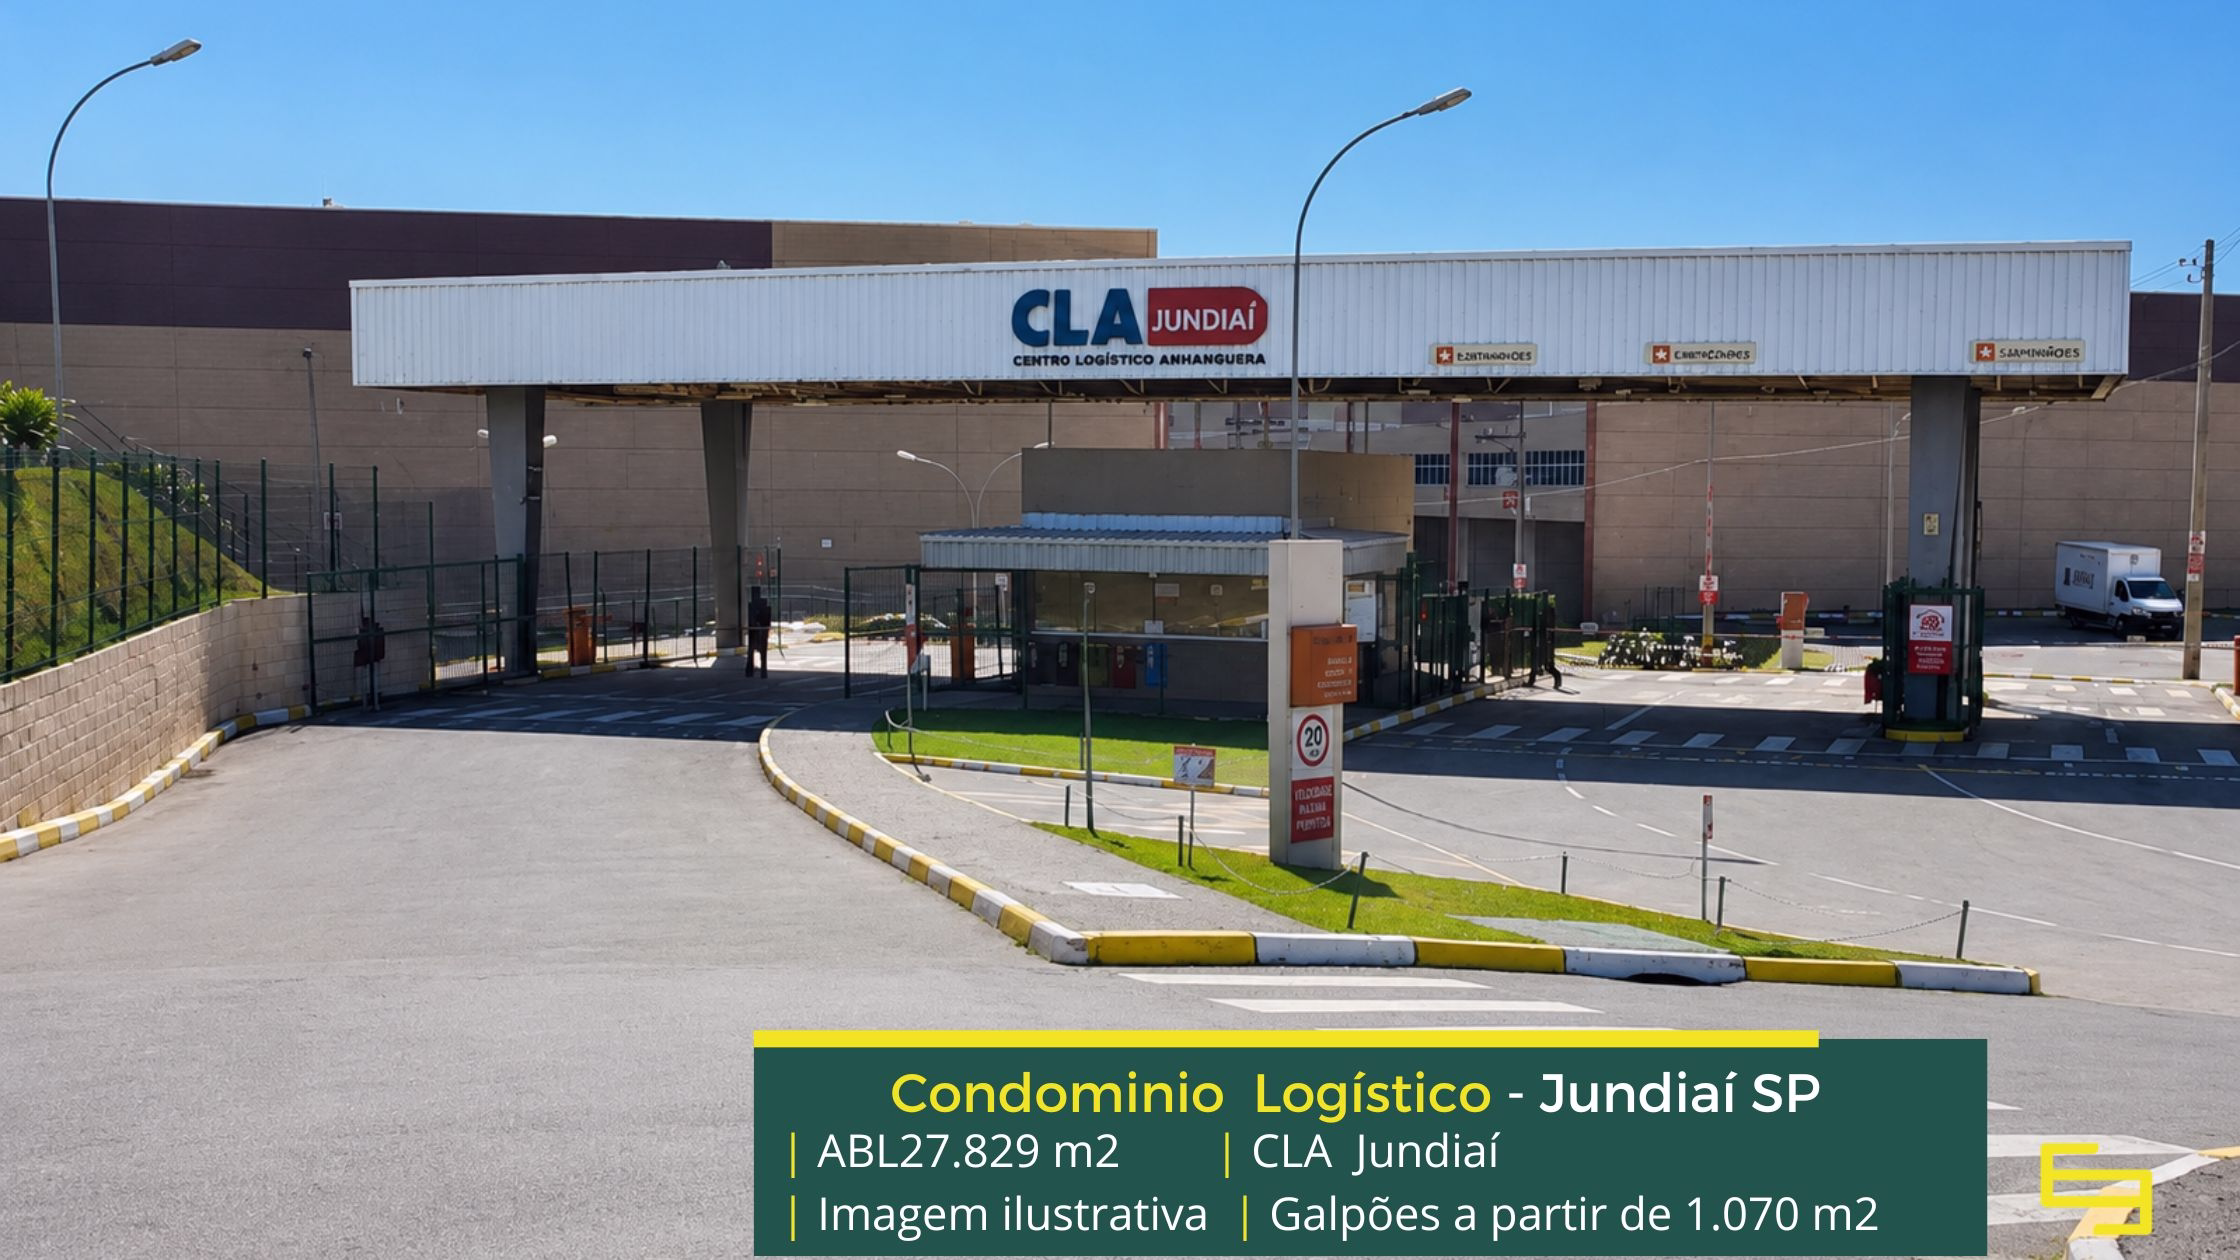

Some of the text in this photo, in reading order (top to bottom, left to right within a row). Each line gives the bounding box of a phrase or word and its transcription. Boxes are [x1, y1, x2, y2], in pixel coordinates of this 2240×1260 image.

[1012, 288, 1256, 347] CLA JUNDIAÍ
[1013, 352, 1266, 366] CENTRO LOGÍSTICO ANHANGUERA
[1304, 725, 1323, 748] 20
